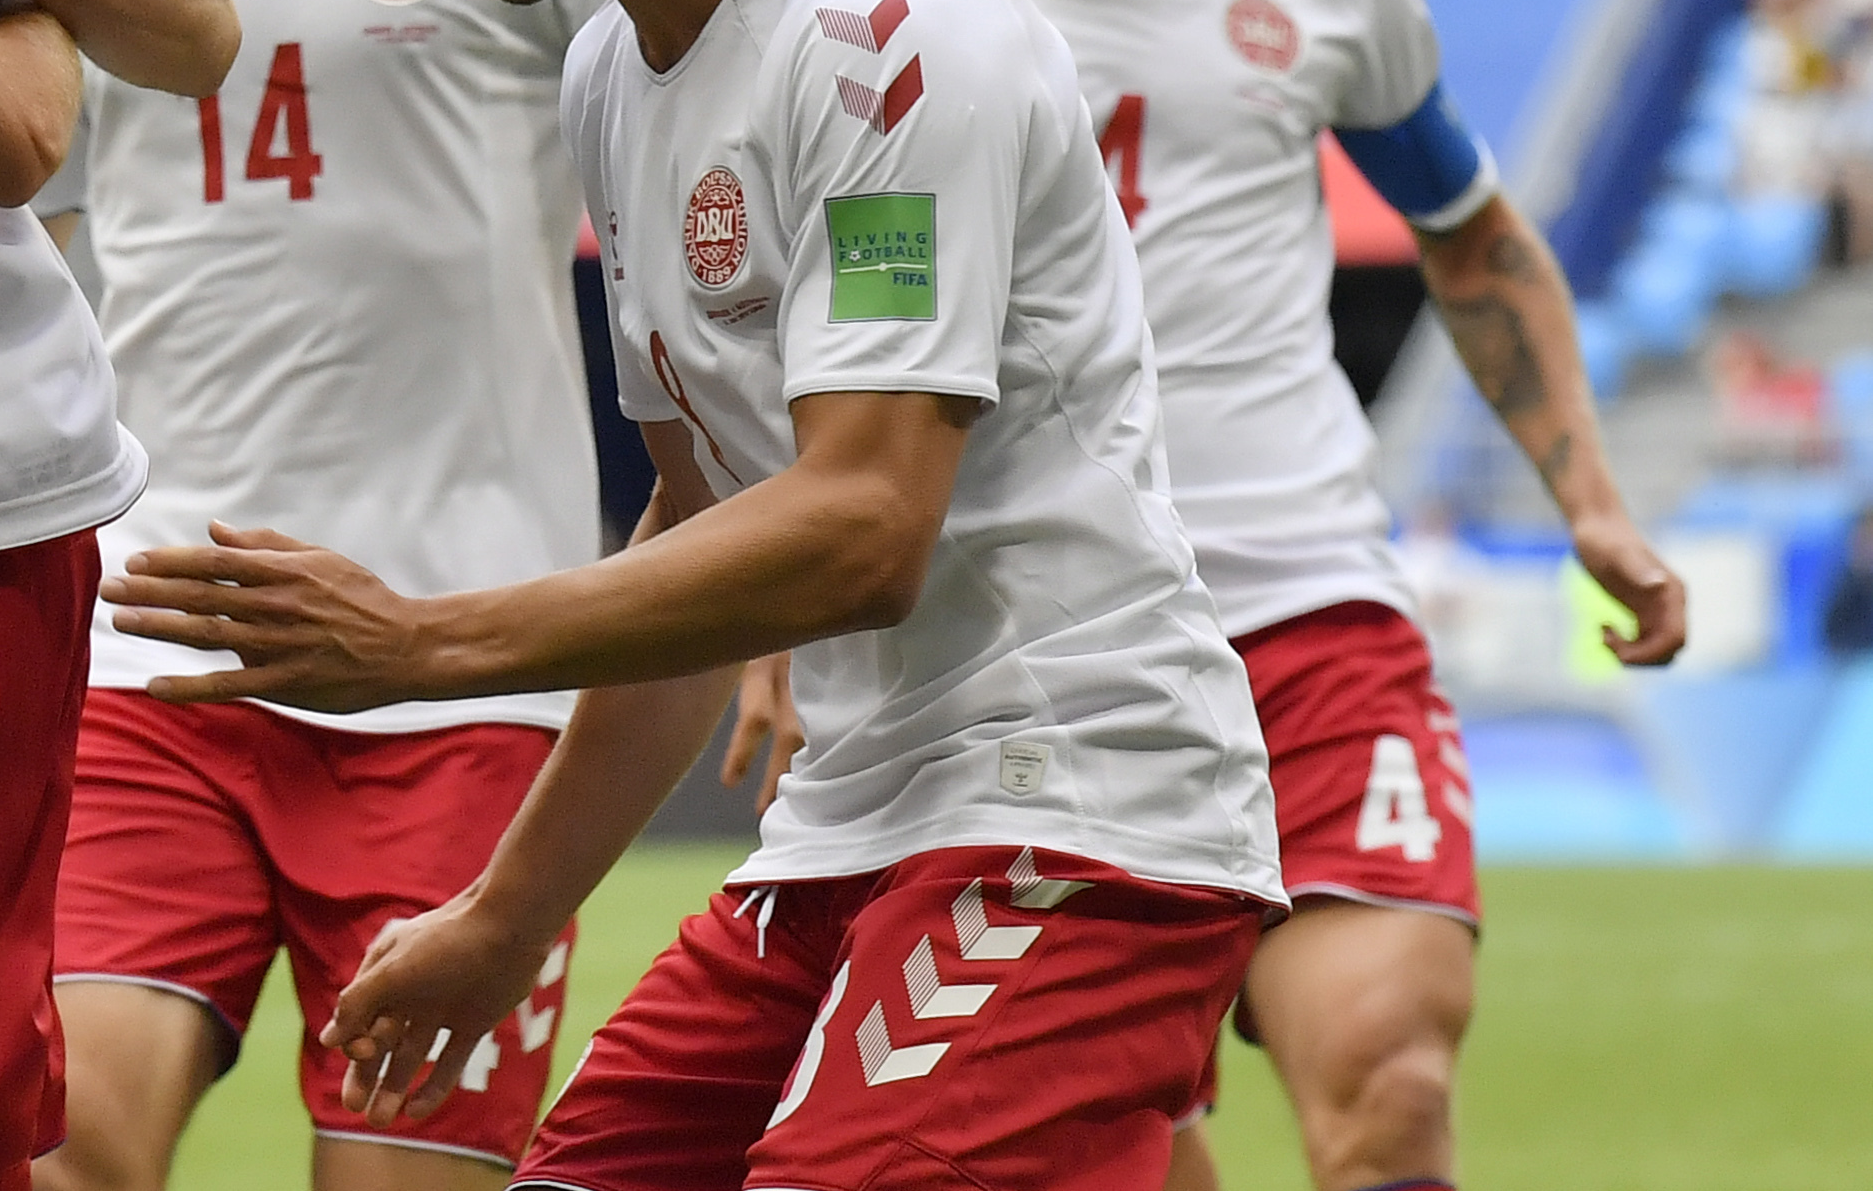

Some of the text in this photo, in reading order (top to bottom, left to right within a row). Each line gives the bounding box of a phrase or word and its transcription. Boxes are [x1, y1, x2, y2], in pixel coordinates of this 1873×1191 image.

[197, 42, 322, 203] 14
[1097, 93, 1149, 231] 4
[695, 207, 735, 243] DBU
[838, 231, 927, 248] LIVING
[701, 267, 732, 284] 1889
[892, 272, 928, 287] FIFA
[1355, 733, 1443, 862] 4
